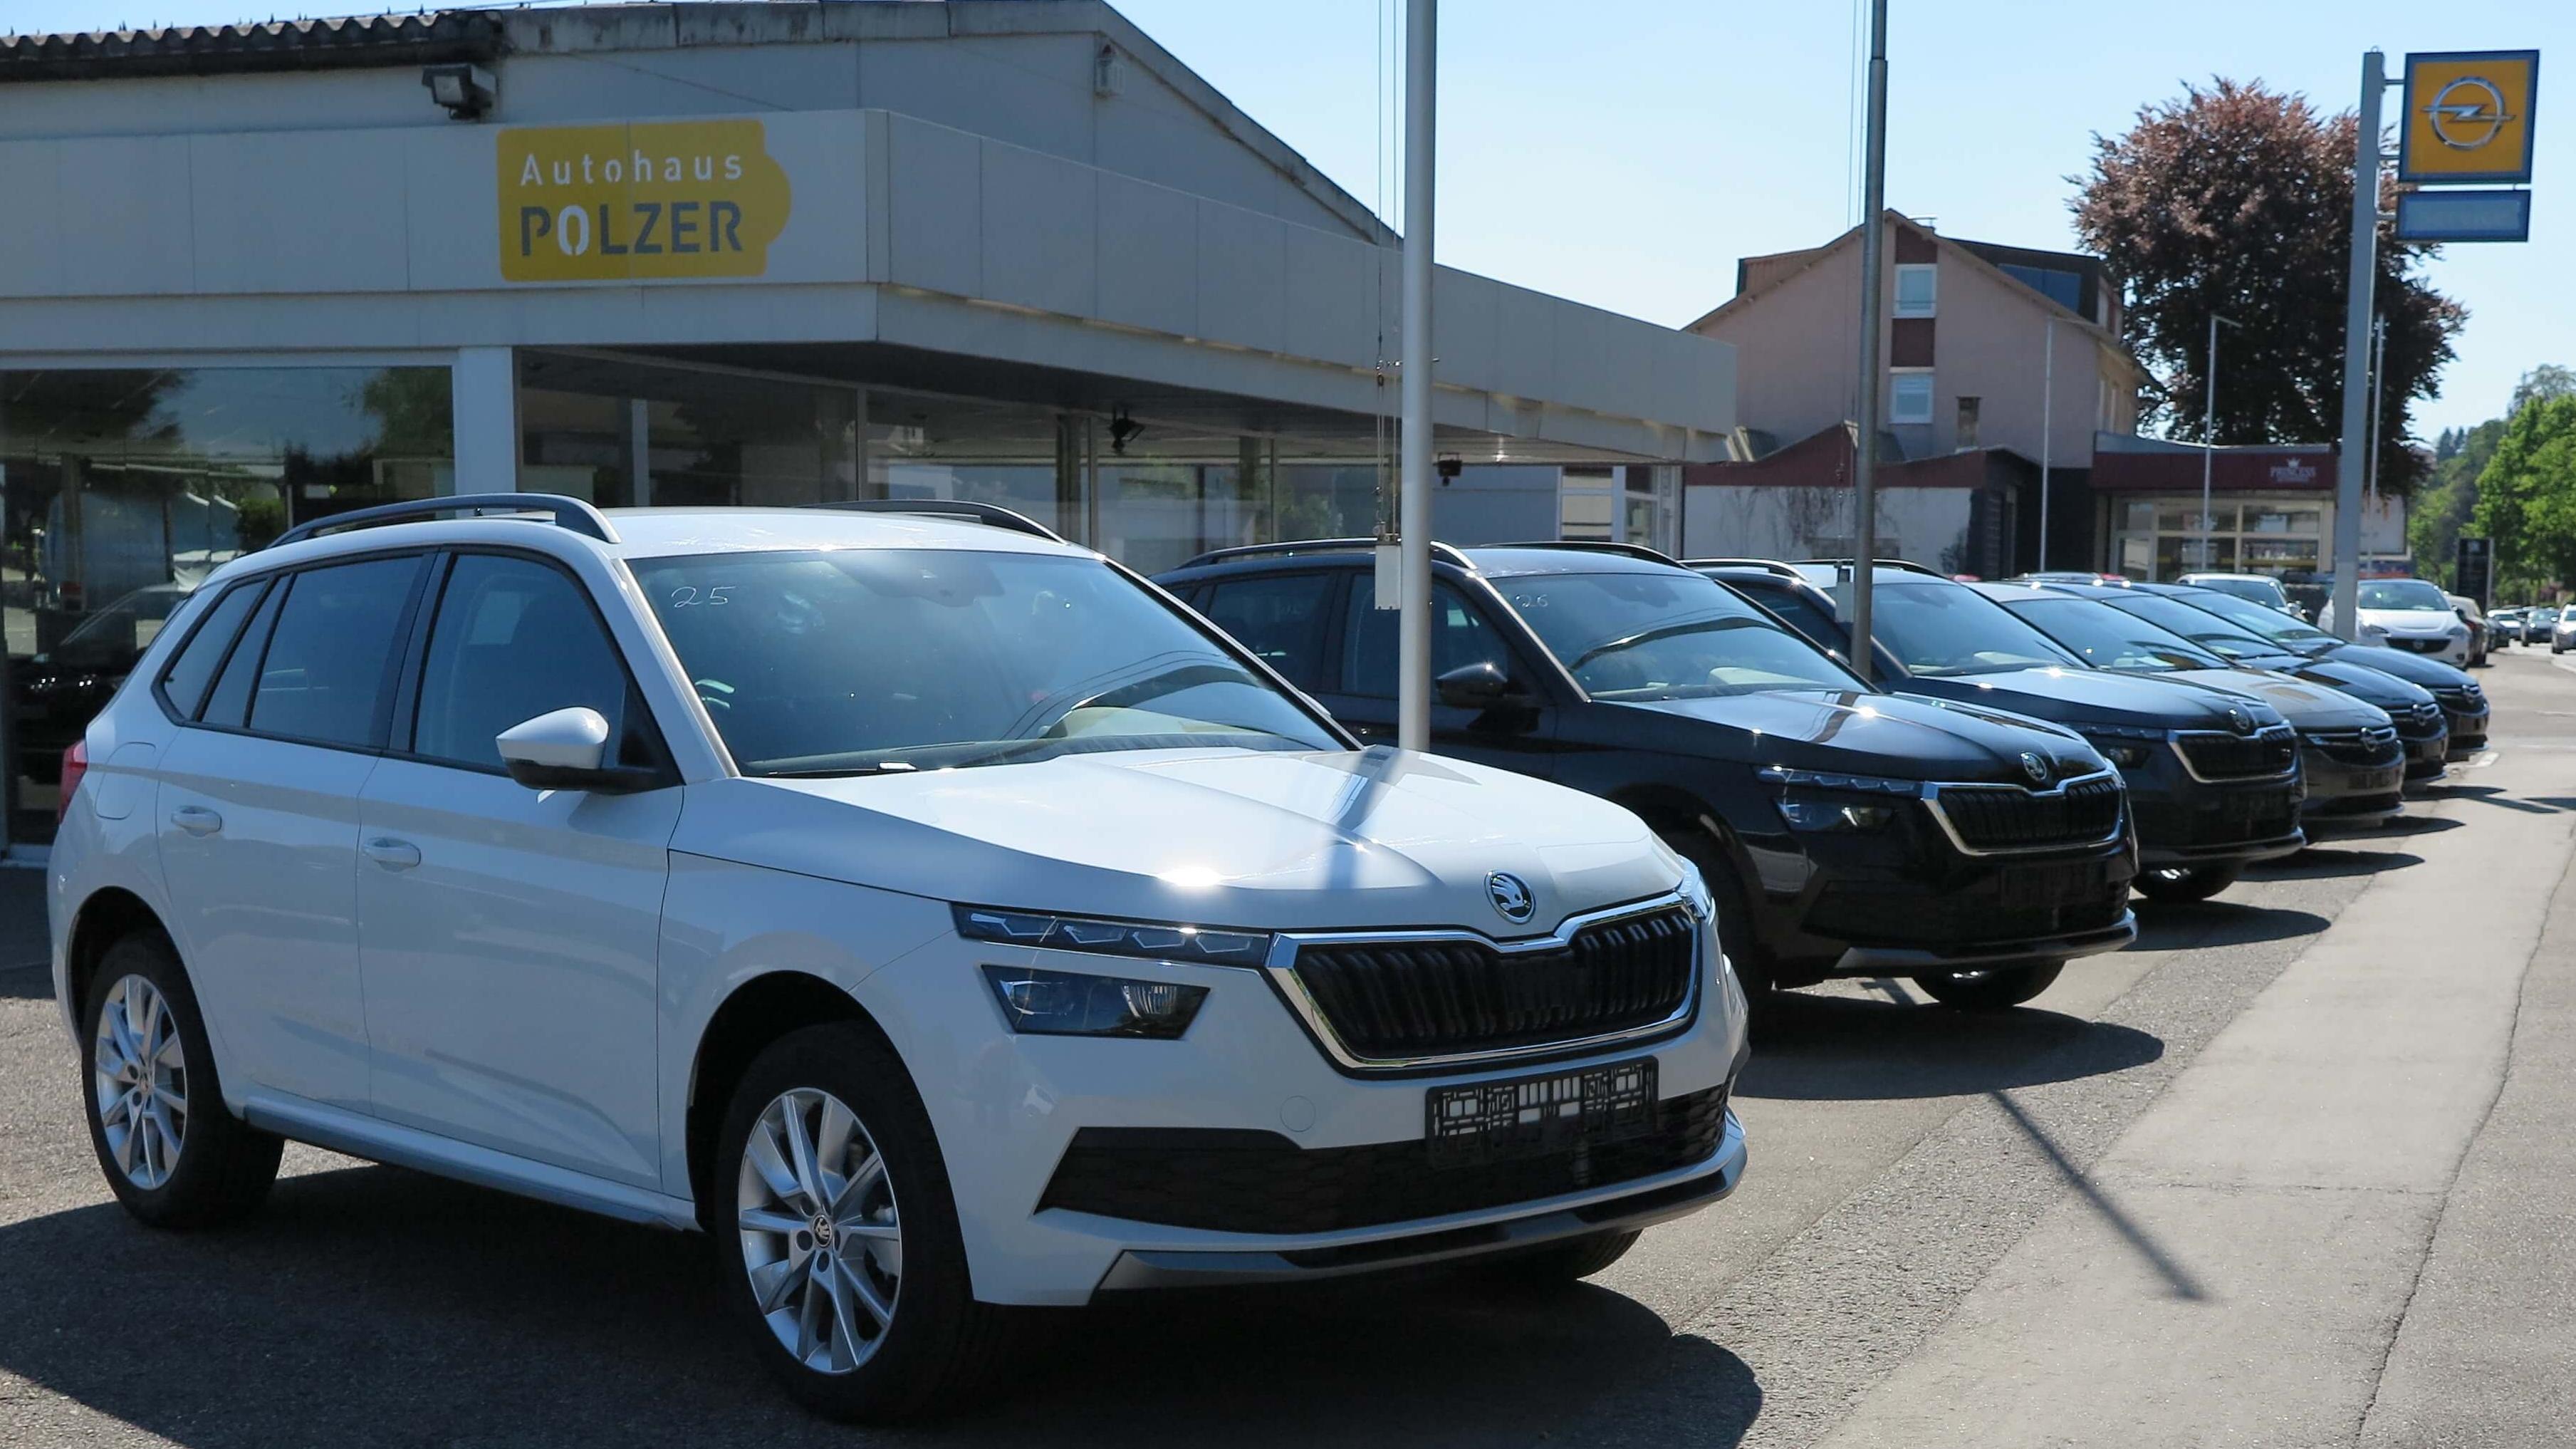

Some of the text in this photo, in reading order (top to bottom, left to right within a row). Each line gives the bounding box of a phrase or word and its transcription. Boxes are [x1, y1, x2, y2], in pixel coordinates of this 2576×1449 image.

[520, 150, 743, 186] Autohaus
[520, 201, 743, 256] POLZER
[671, 586, 736, 608] 25
